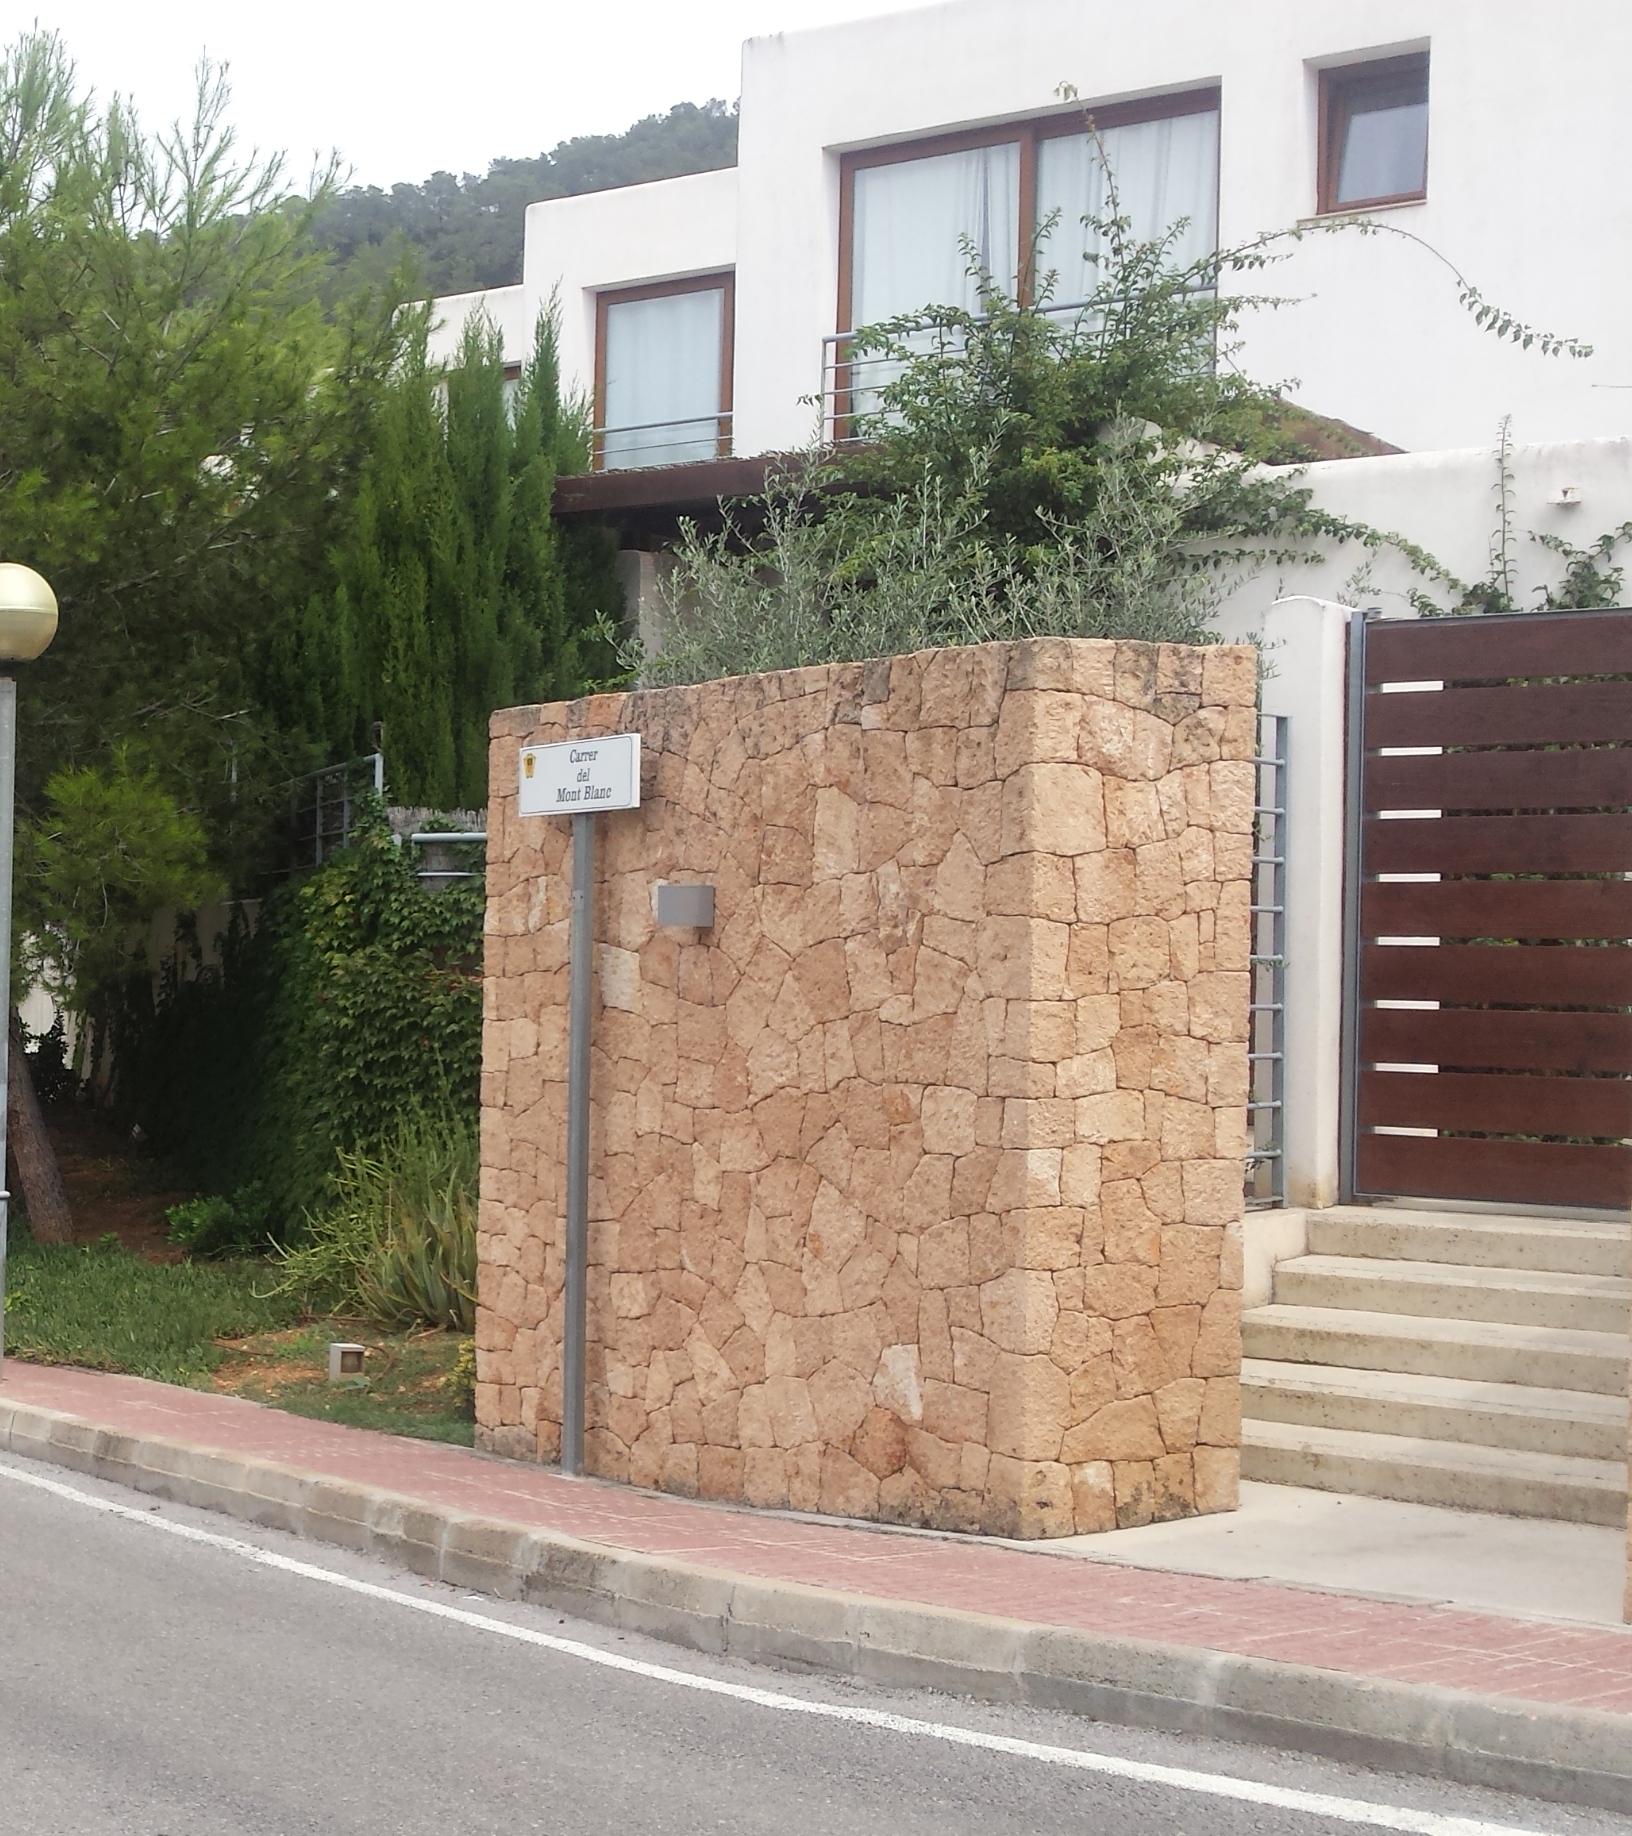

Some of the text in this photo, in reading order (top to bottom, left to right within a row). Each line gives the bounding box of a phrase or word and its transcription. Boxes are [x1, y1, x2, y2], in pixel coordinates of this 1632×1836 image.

[569, 749, 598, 763] Carrer
[576, 768, 590, 782] del
[556, 785, 612, 802] Mont Blanc
